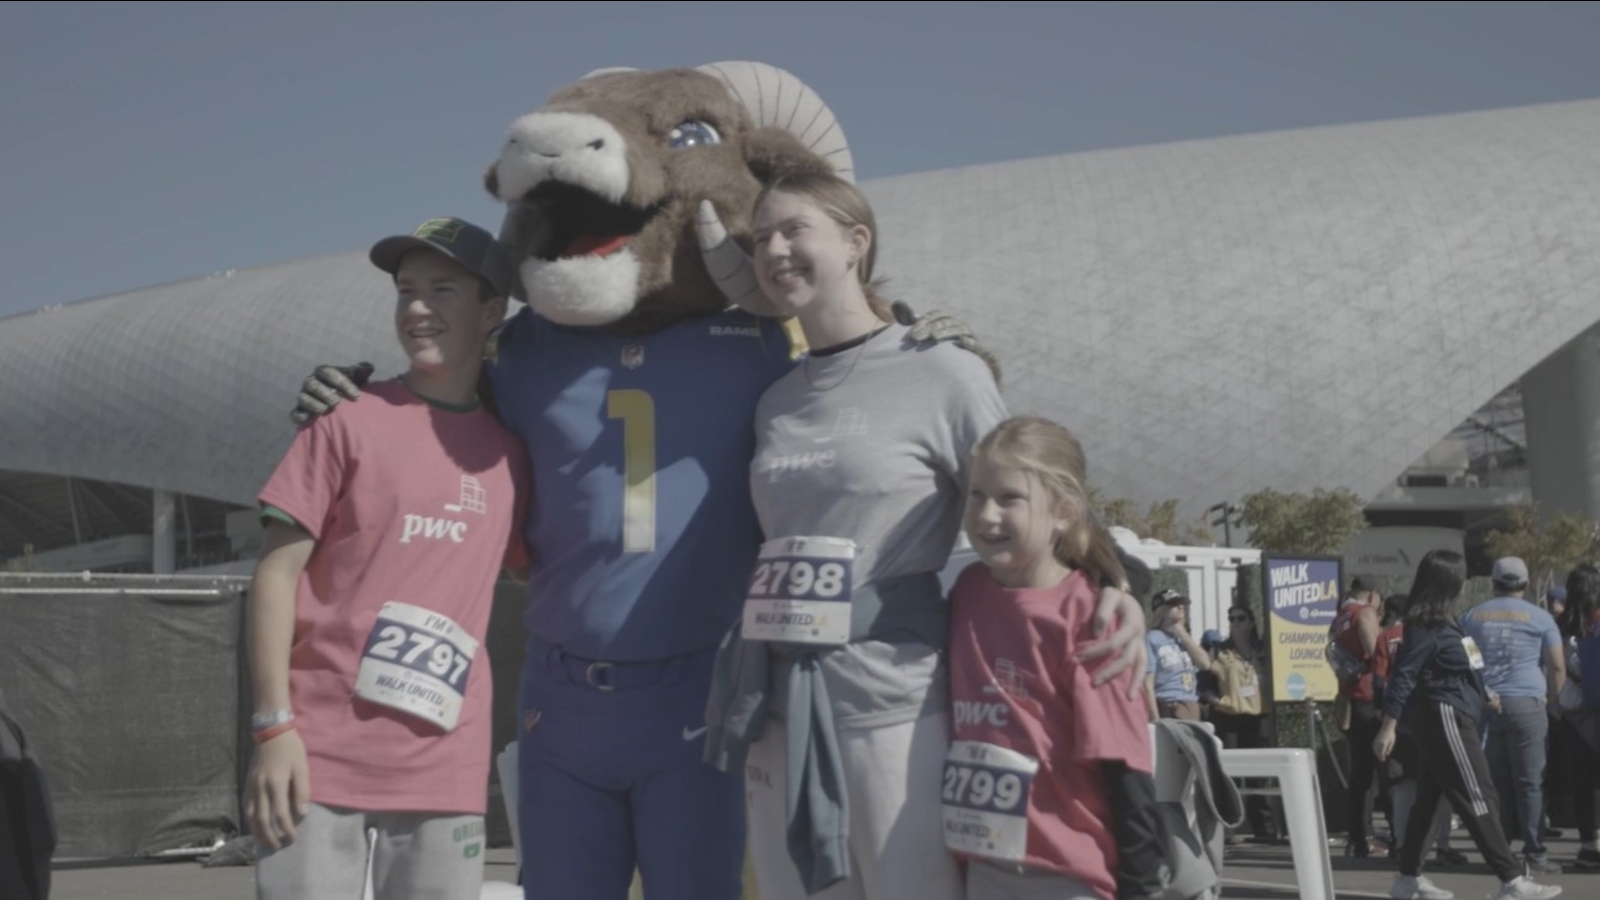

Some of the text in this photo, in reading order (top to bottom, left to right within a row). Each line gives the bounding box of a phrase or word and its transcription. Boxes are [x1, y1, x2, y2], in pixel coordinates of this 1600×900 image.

[709, 325, 761, 337] RAMS
[607, 388, 656, 553] 1
[399, 513, 468, 543] pwc
[749, 560, 845, 598] 2798
[1270, 562, 1309, 588] WALK
[1279, 631, 1329, 645] CHAMPION
[368, 625, 470, 686] 2797
[1289, 647, 1325, 660] LOUNGE
[375, 673, 406, 693] WALK
[952, 700, 1009, 733] pwc
[943, 764, 1022, 811] 2799
